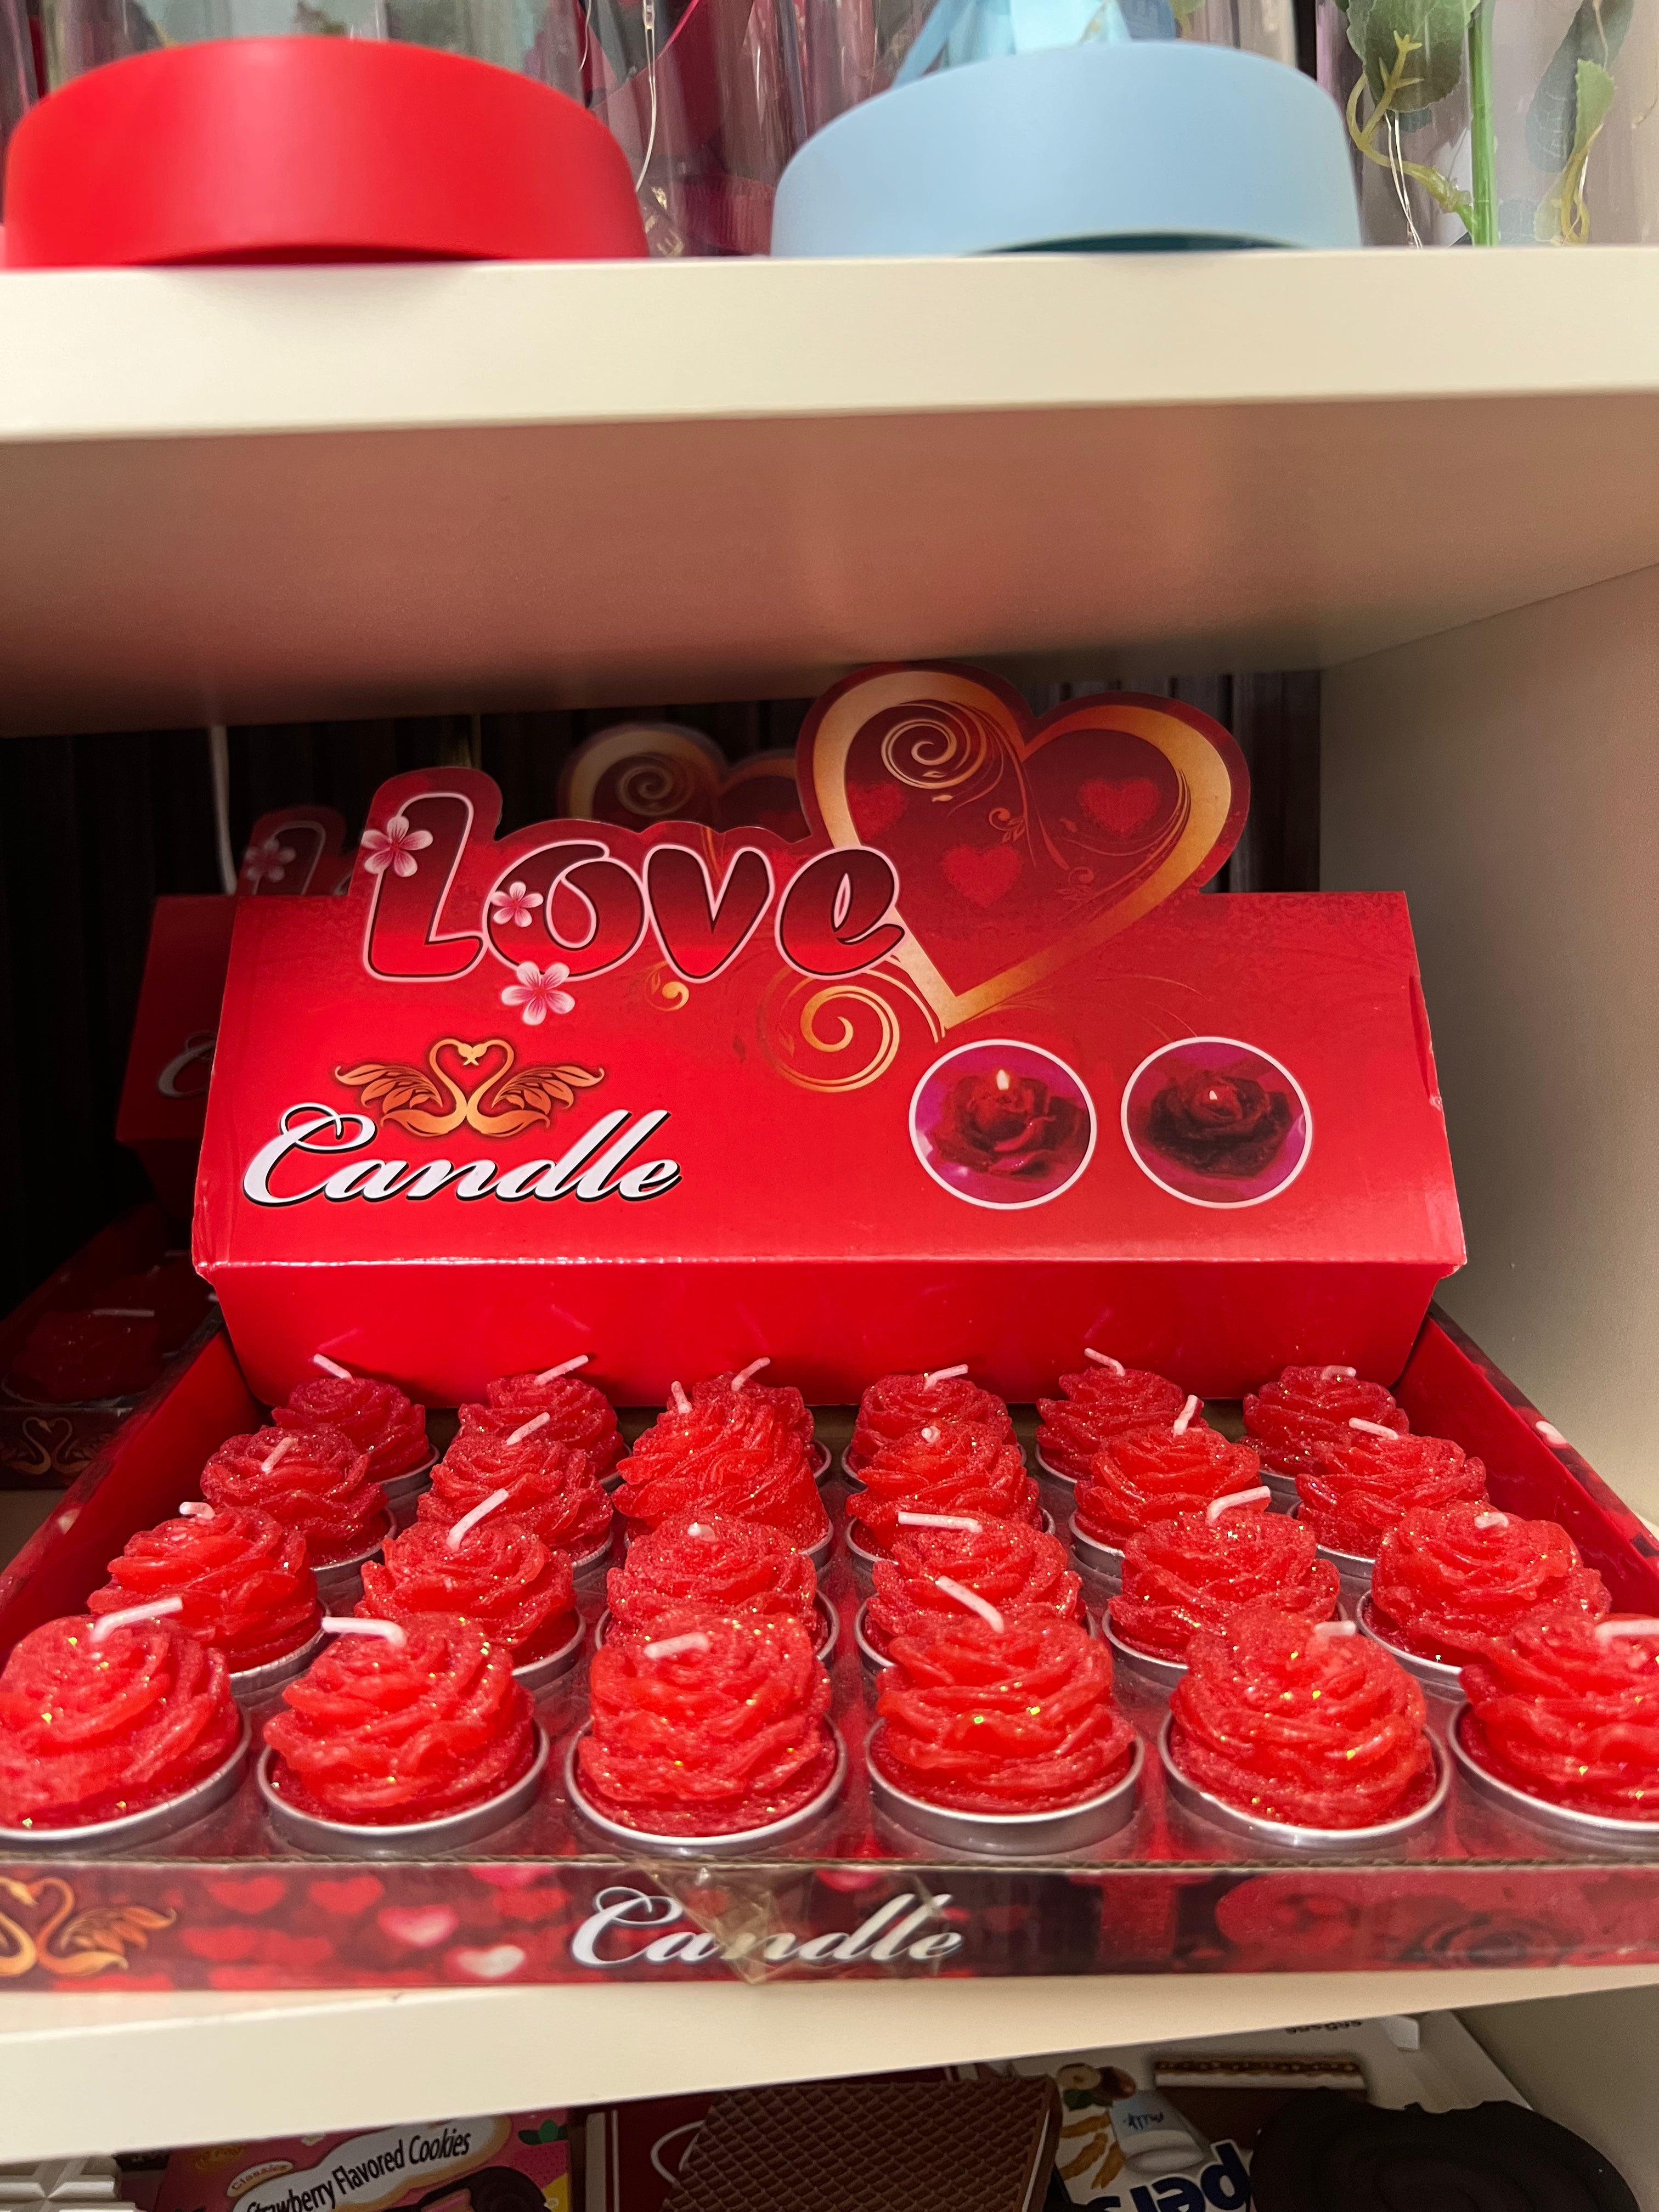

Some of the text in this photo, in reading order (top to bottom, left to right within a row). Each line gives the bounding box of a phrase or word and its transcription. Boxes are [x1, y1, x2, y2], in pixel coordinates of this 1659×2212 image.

[363, 792, 906, 984] Love
[242, 1102, 681, 1206] Candle
[571, 1886, 963, 1967] Candle
[332, 2138, 405, 2195] Flavored
[409, 2128, 471, 2165] Cookies
